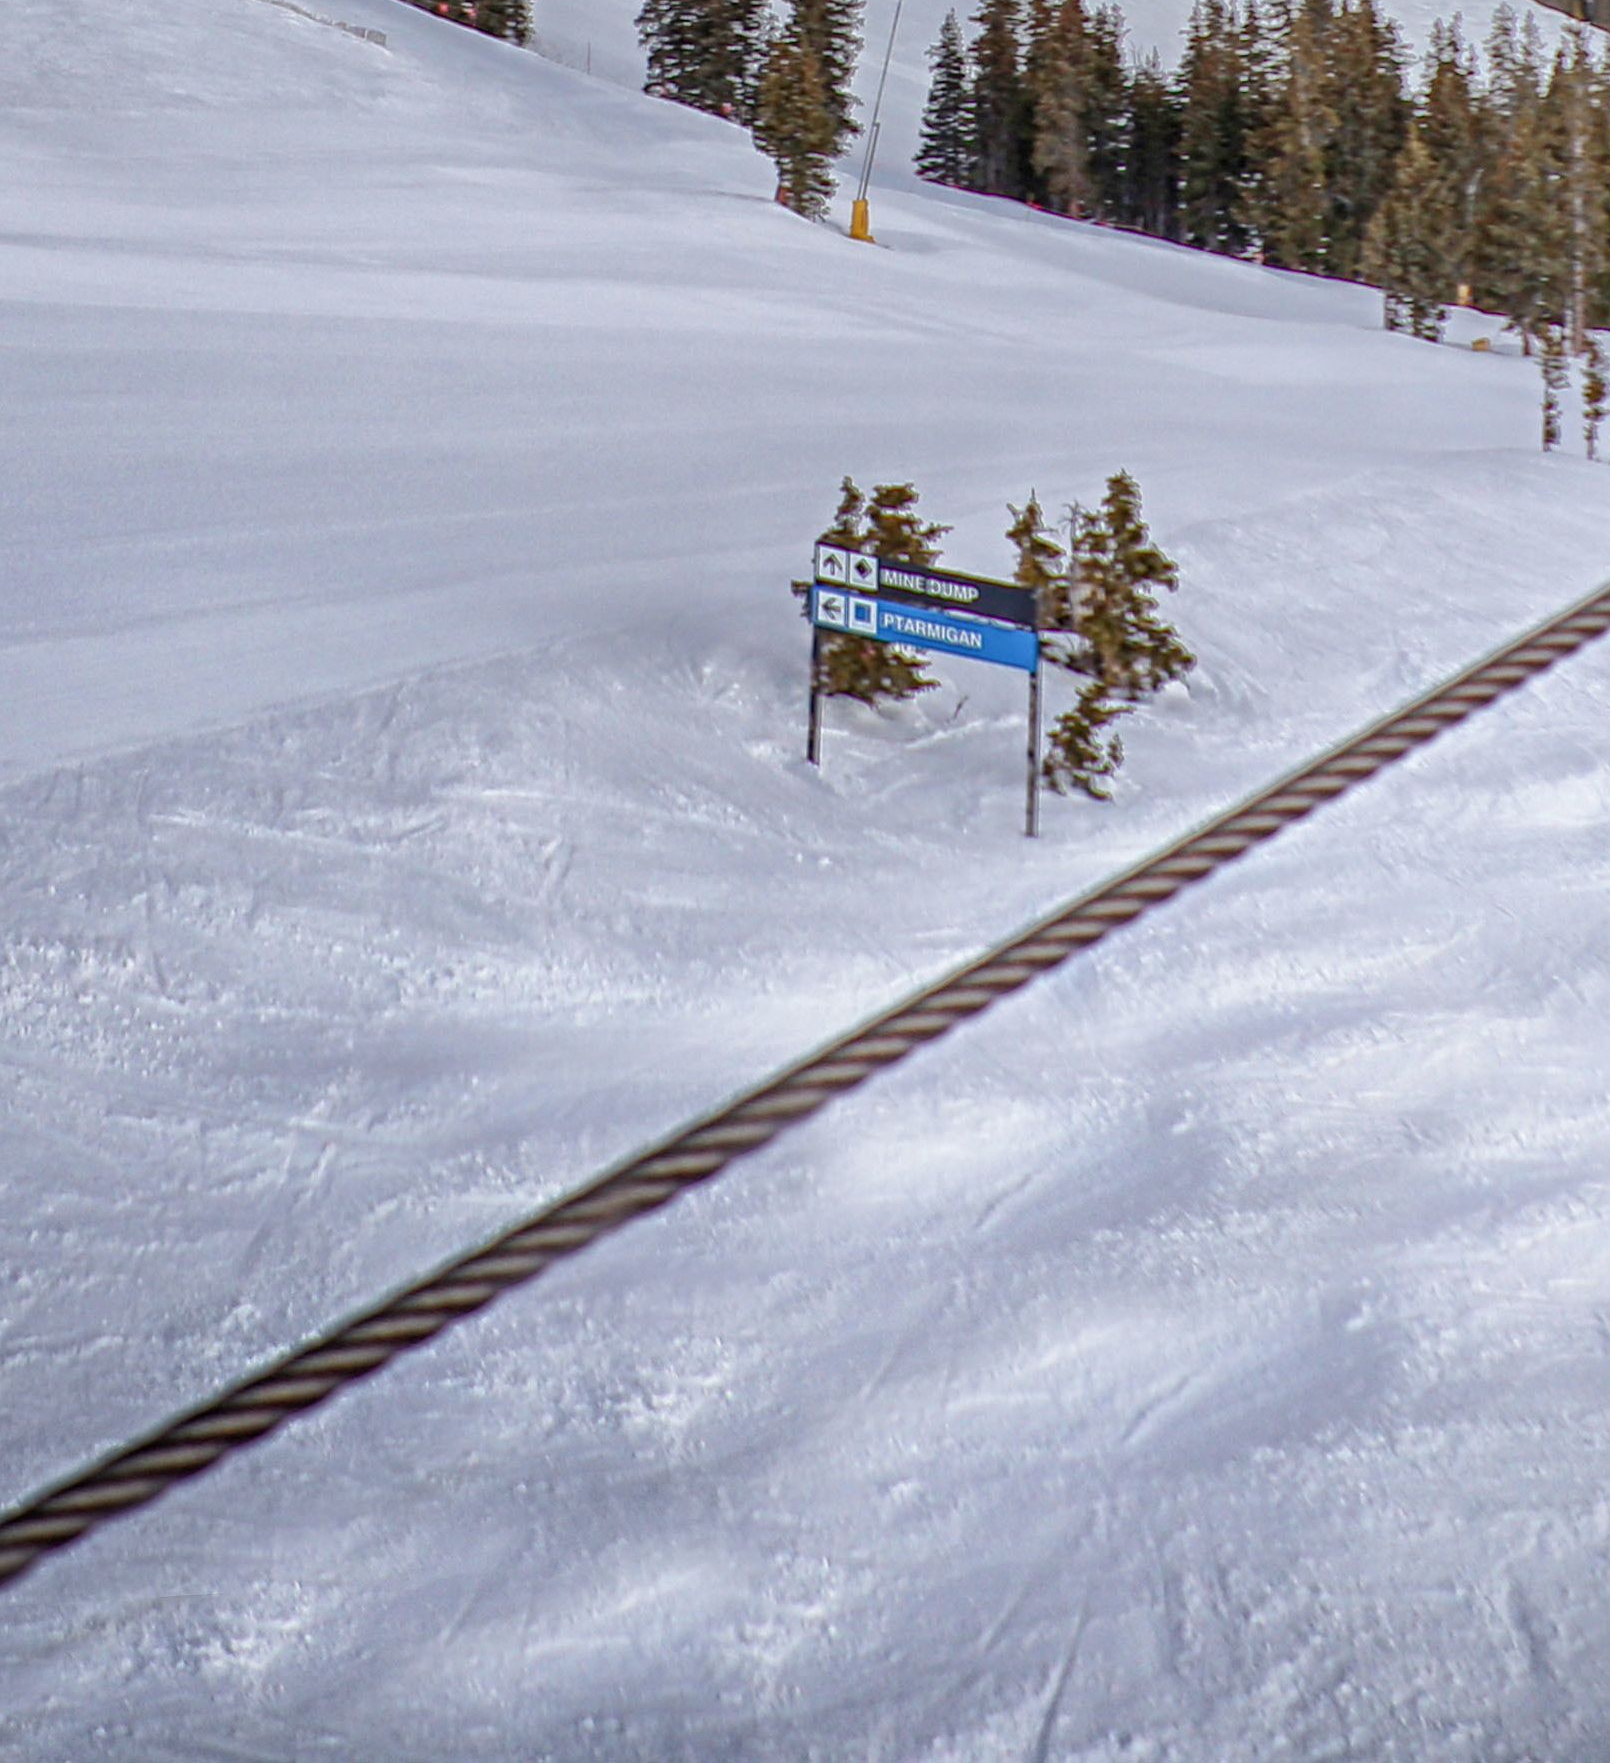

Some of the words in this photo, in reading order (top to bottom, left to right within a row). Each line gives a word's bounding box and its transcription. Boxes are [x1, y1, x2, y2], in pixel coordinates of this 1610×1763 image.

[883, 569, 926, 593] MINE
[927, 577, 979, 603] DUMP
[883, 613, 982, 649] PTARMIGAN
